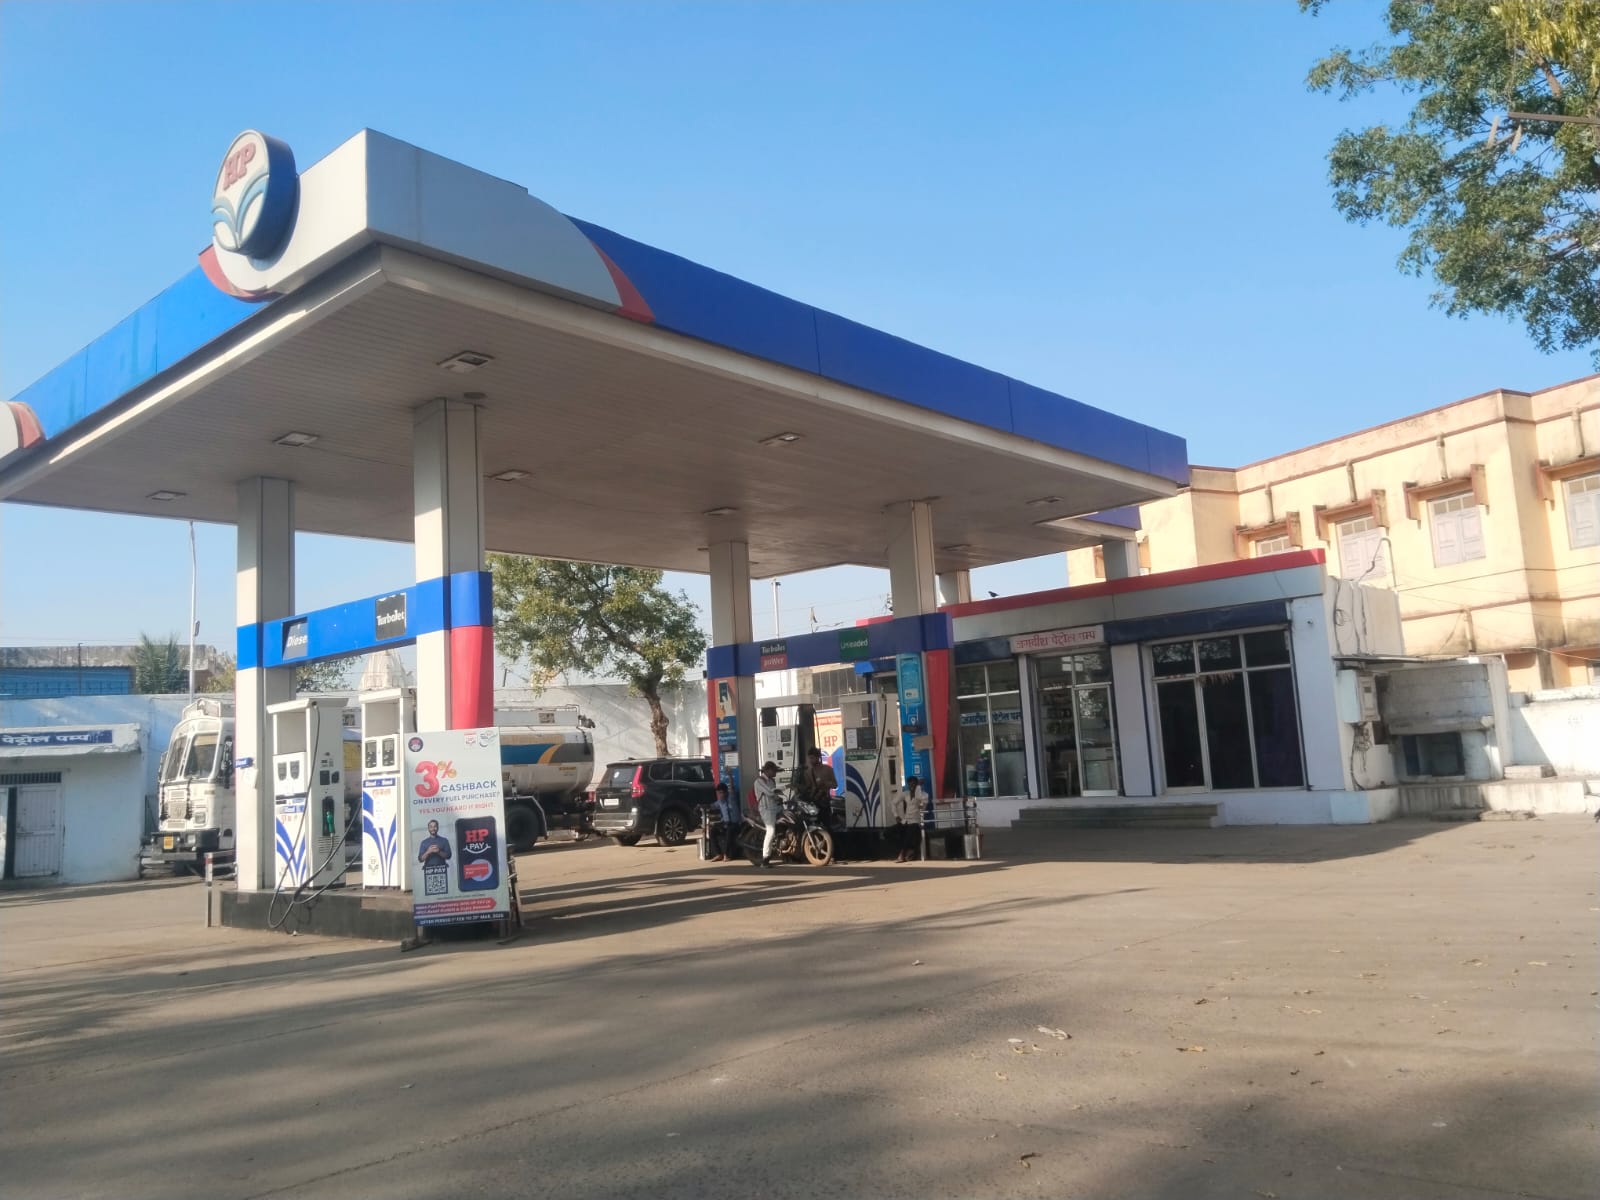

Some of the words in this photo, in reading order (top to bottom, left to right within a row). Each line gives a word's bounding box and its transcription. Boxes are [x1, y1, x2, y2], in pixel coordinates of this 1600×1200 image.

[223, 142, 256, 191] HP
[824, 735, 838, 747] HP
[415, 760, 457, 798] 3%
[441, 780, 498, 793] CASHBACK
[465, 828, 489, 843] HP
[469, 842, 485, 850] PAY
